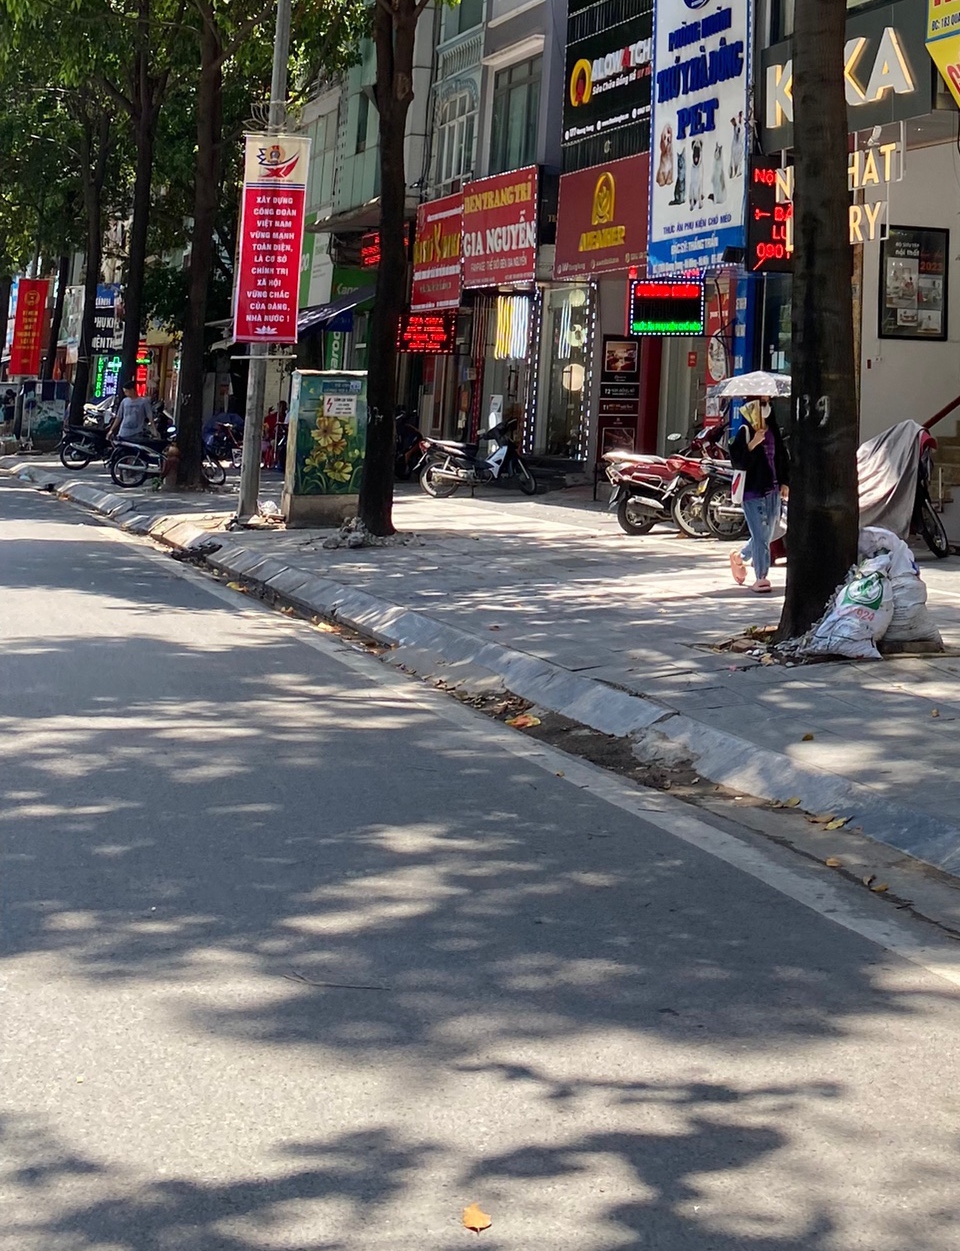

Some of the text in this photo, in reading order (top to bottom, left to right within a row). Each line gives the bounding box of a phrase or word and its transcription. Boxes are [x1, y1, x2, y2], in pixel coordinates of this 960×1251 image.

[941, 16, 951, 28] 183
[676, 97, 720, 140] PET
[481, 185, 516, 211] TRANG
[257, 219, 292, 229] VIỆT NAM
[464, 230, 485, 257] GIA
[486, 210, 537, 254] NGUYỄN
